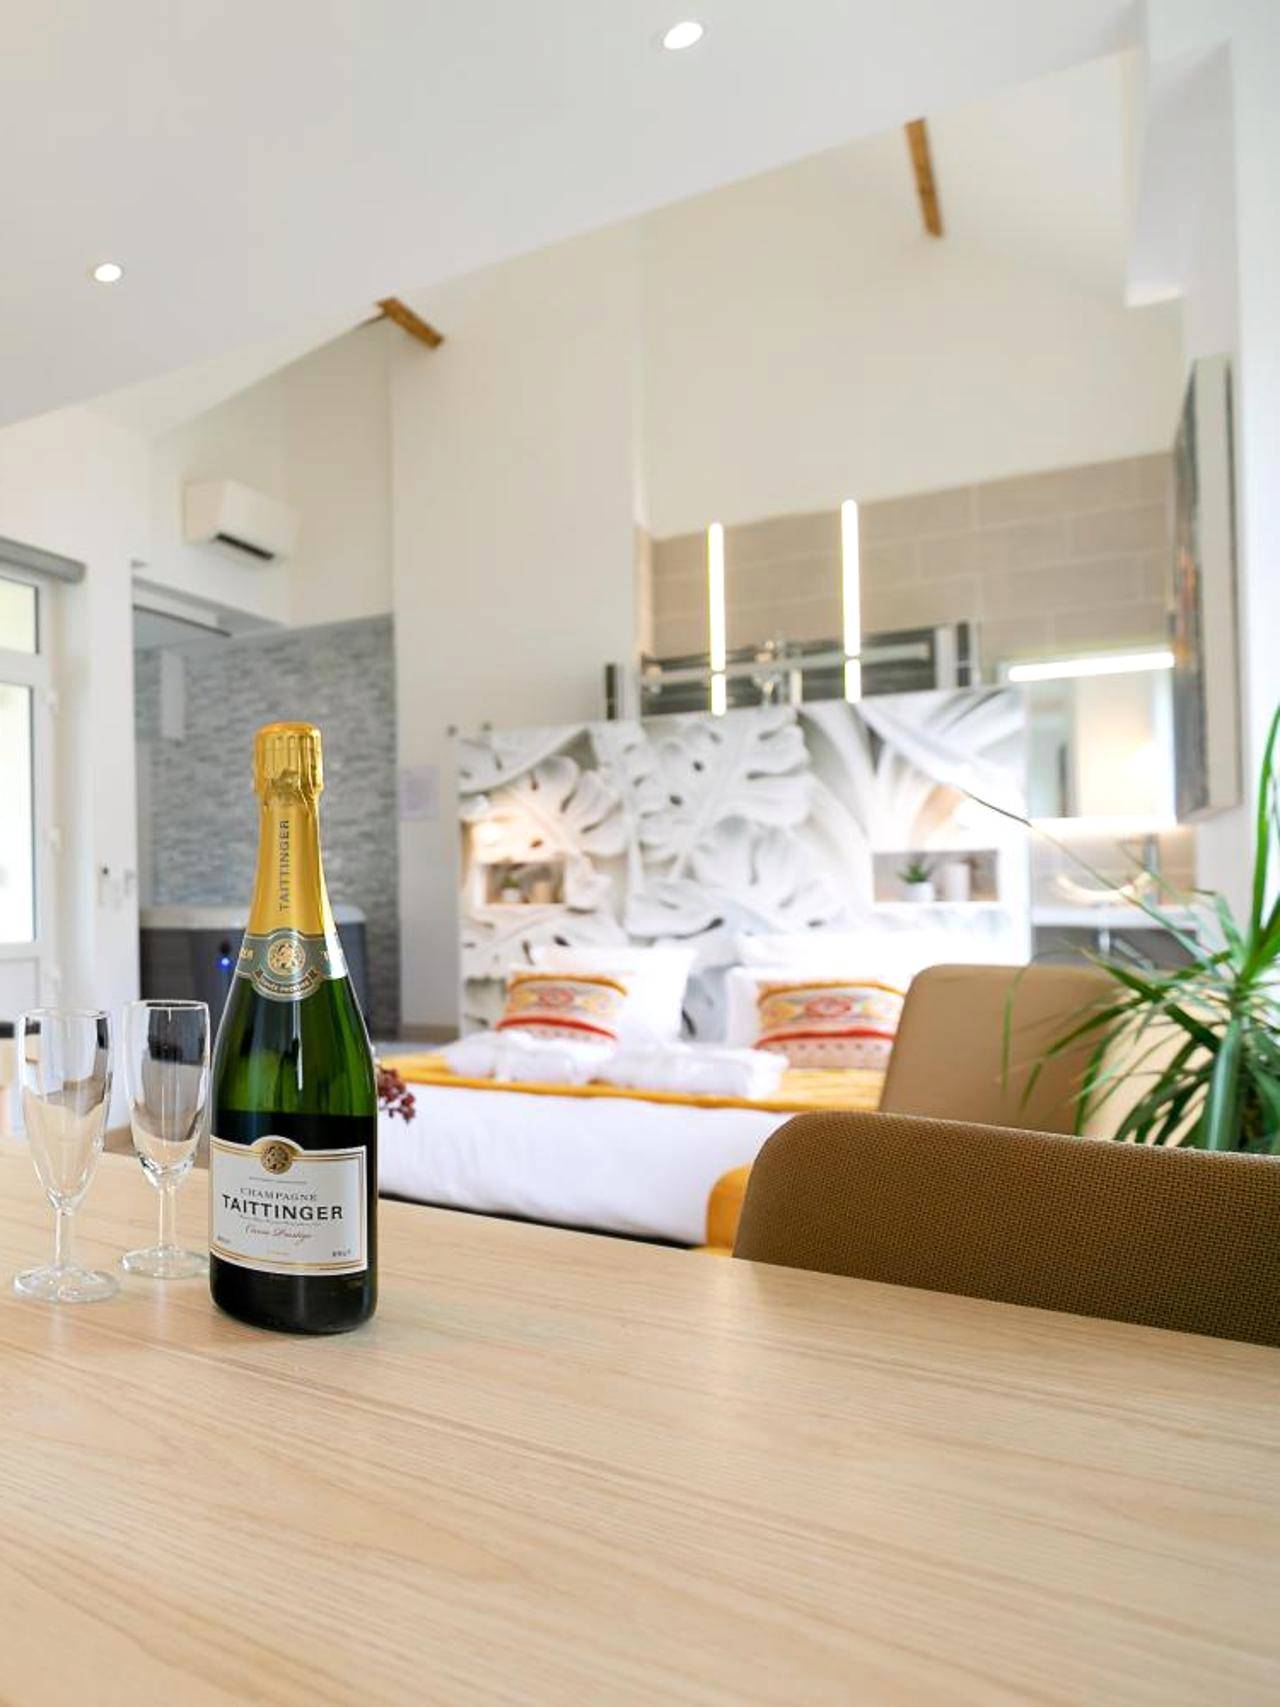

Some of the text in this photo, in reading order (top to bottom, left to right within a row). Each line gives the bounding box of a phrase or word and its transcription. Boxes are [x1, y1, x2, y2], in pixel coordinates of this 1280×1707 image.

[278, 819, 290, 913] TAITTINGER
[222, 1194, 344, 1221] TAITTINGER
[240, 1187, 318, 1201] CHAMPAGNE
